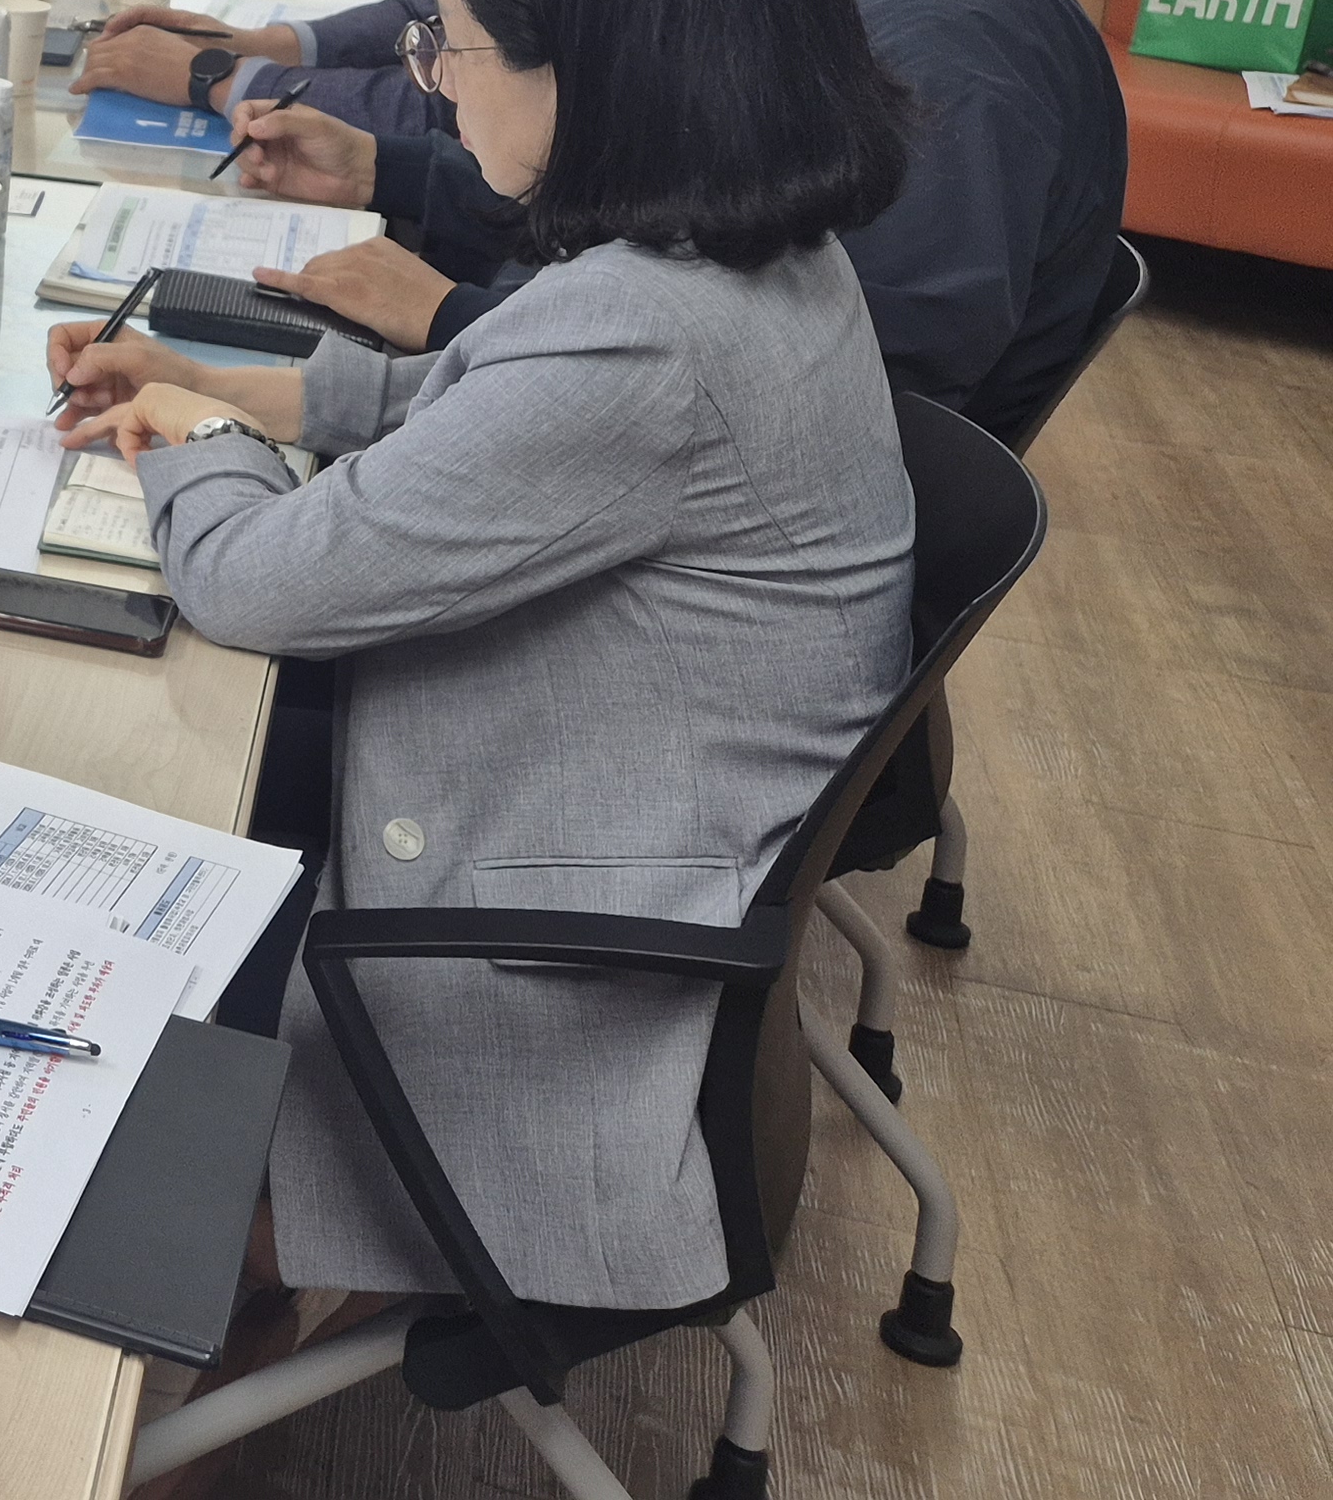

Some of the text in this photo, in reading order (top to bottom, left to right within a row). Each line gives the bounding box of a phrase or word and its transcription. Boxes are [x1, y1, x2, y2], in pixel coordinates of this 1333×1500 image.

[16, 1096, 39, 1122] 주민들의
[32, 1076, 51, 1095] 민원을
[8, 1165, 24, 1181] 처리
